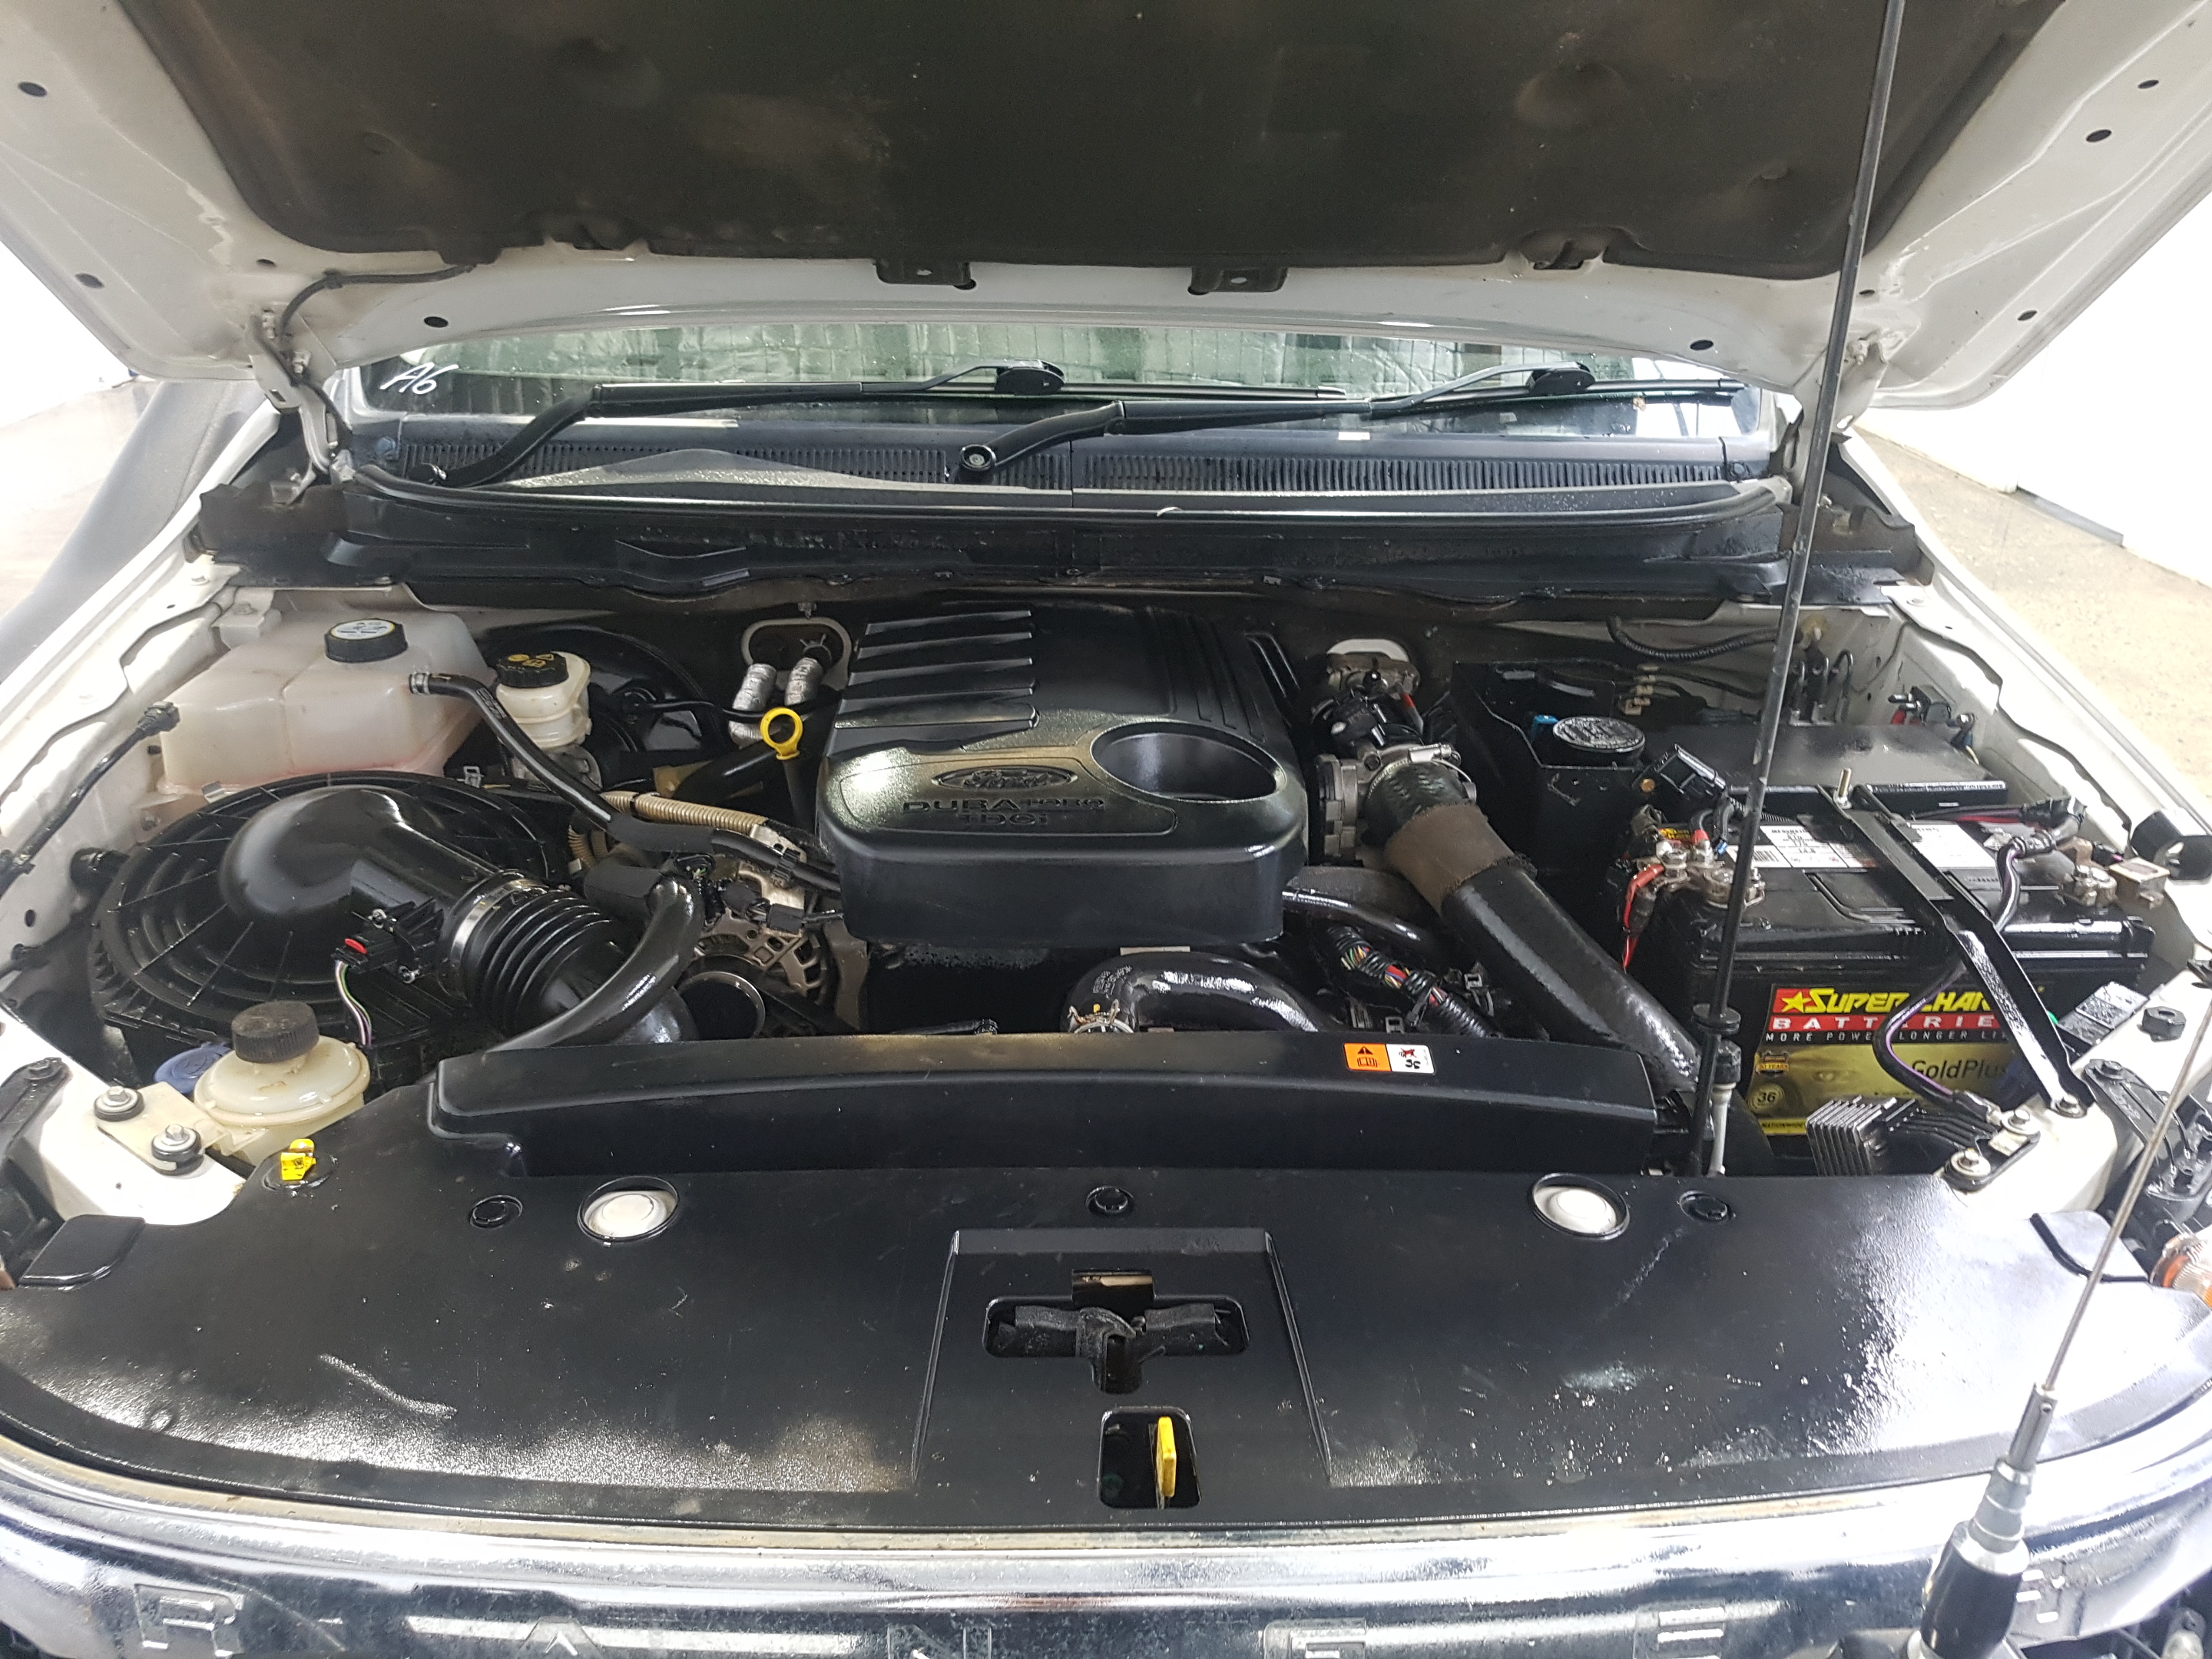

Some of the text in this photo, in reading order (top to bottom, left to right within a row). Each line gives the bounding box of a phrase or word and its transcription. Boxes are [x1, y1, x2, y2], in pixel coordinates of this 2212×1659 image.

[379, 362, 459, 395] A6
[1804, 988, 1992, 1013] SUPER HAR
[1772, 1015, 1995, 1030] BATTRIE
[1765, 1031, 1813, 1042] MORE
[1826, 1031, 1873, 1041] POWE
[1899, 1031, 1968, 1041] LONGER
[1912, 1059, 2007, 1078] GoldPlus
[1757, 1091, 1777, 1103] 36
